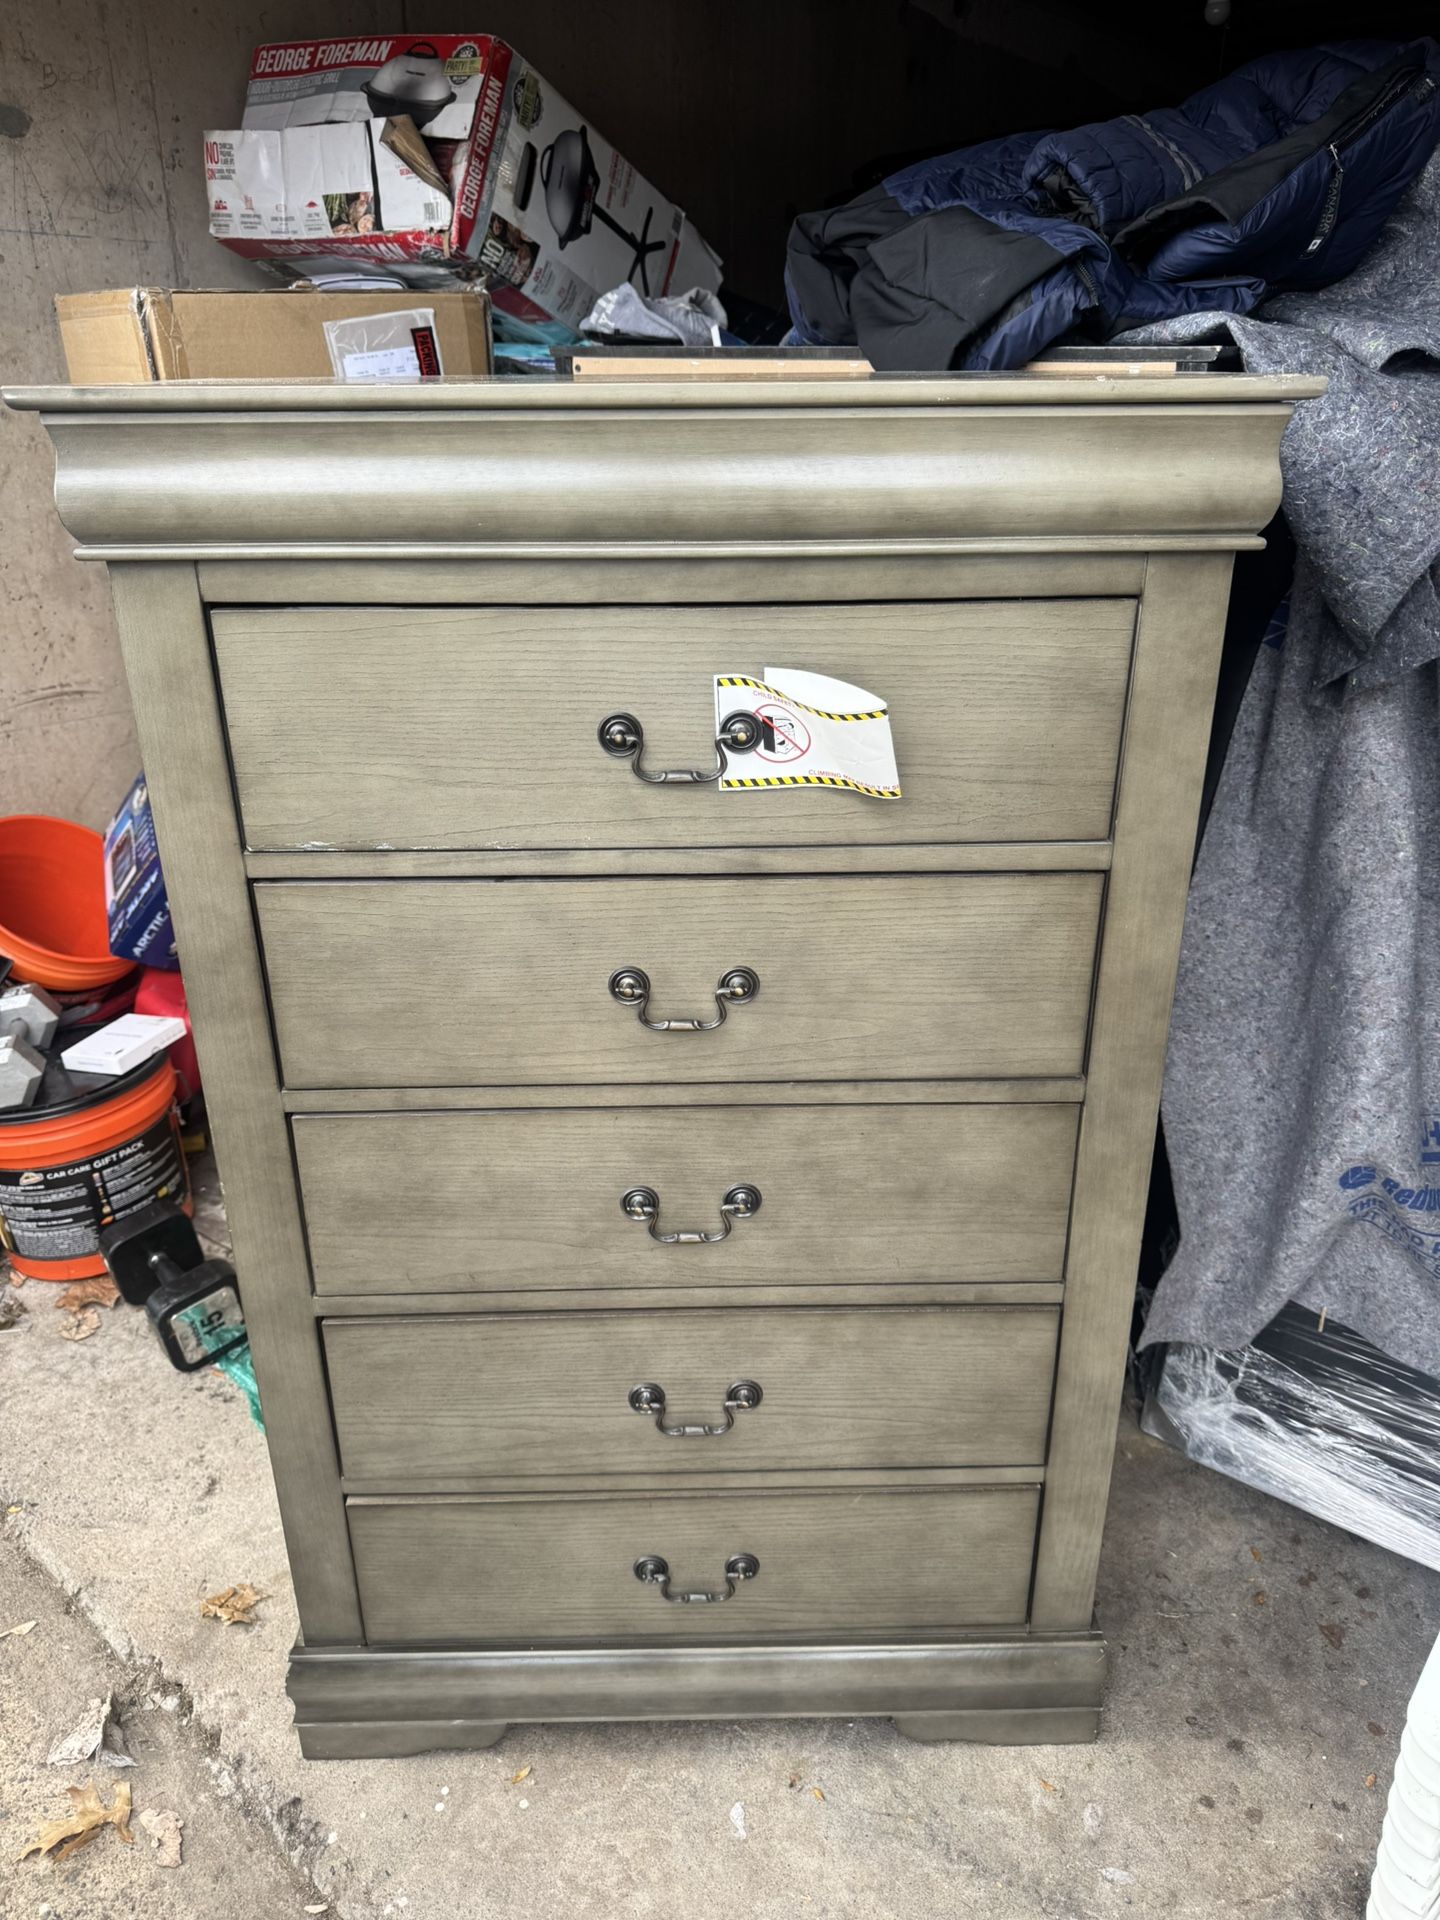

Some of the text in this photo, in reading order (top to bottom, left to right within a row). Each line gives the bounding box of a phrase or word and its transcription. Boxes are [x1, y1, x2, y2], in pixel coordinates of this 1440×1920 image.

[256, 41, 392, 73] GEORGE FOREMAN
[205, 141, 220, 165] NO
[460, 160, 484, 220] GEORGE
[474, 76, 503, 157] FOREMAN
[1320, 179, 1340, 234] CANADA
[480, 238, 505, 269] NO
[753, 690, 773, 700] CHILD
[808, 769, 842, 778] CLIMBING
[132, 911, 168, 958] ARCTIC
[46, 1139, 145, 1181] CAR CARE GIFT PACK
[201, 1310, 227, 1337] 15
